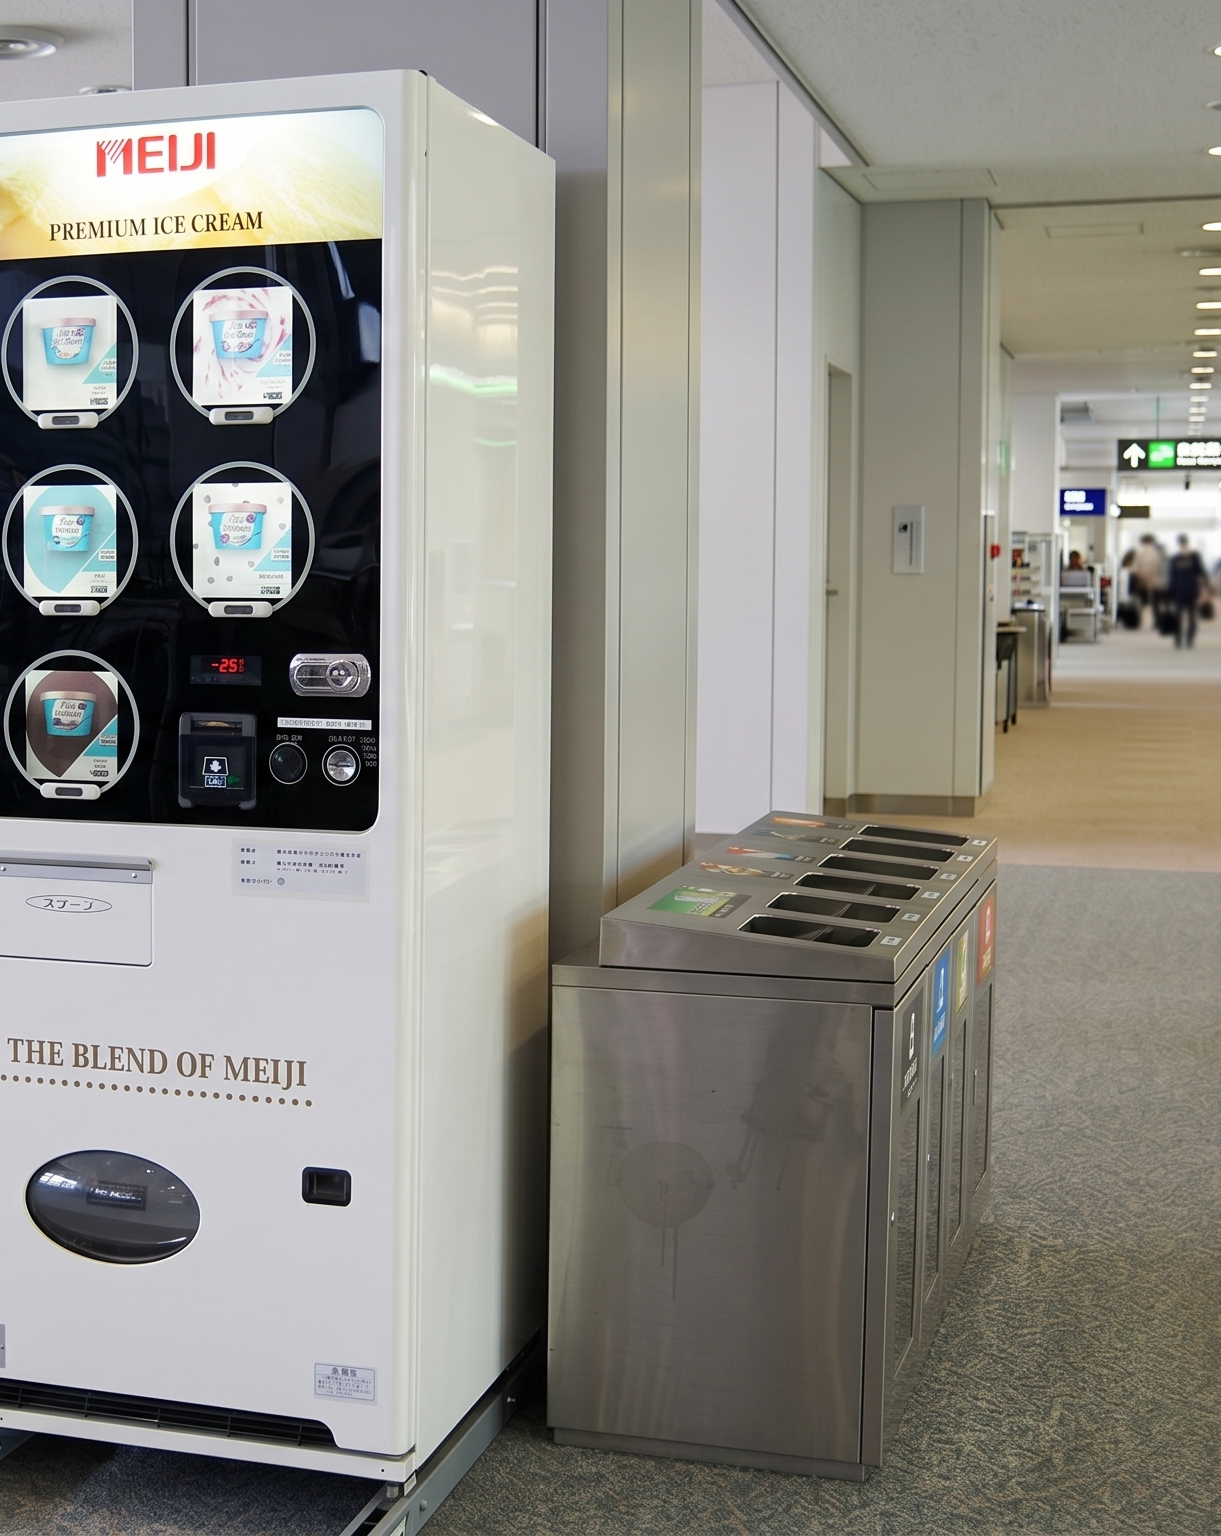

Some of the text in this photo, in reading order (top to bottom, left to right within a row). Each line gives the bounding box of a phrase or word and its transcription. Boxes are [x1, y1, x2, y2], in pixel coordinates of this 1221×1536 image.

[96, 132, 215, 177] MEIJI
[50, 212, 264, 242] PREMIUM ICE CREAM
[7, 1037, 307, 1090] THE BLEND OF MEIJI
